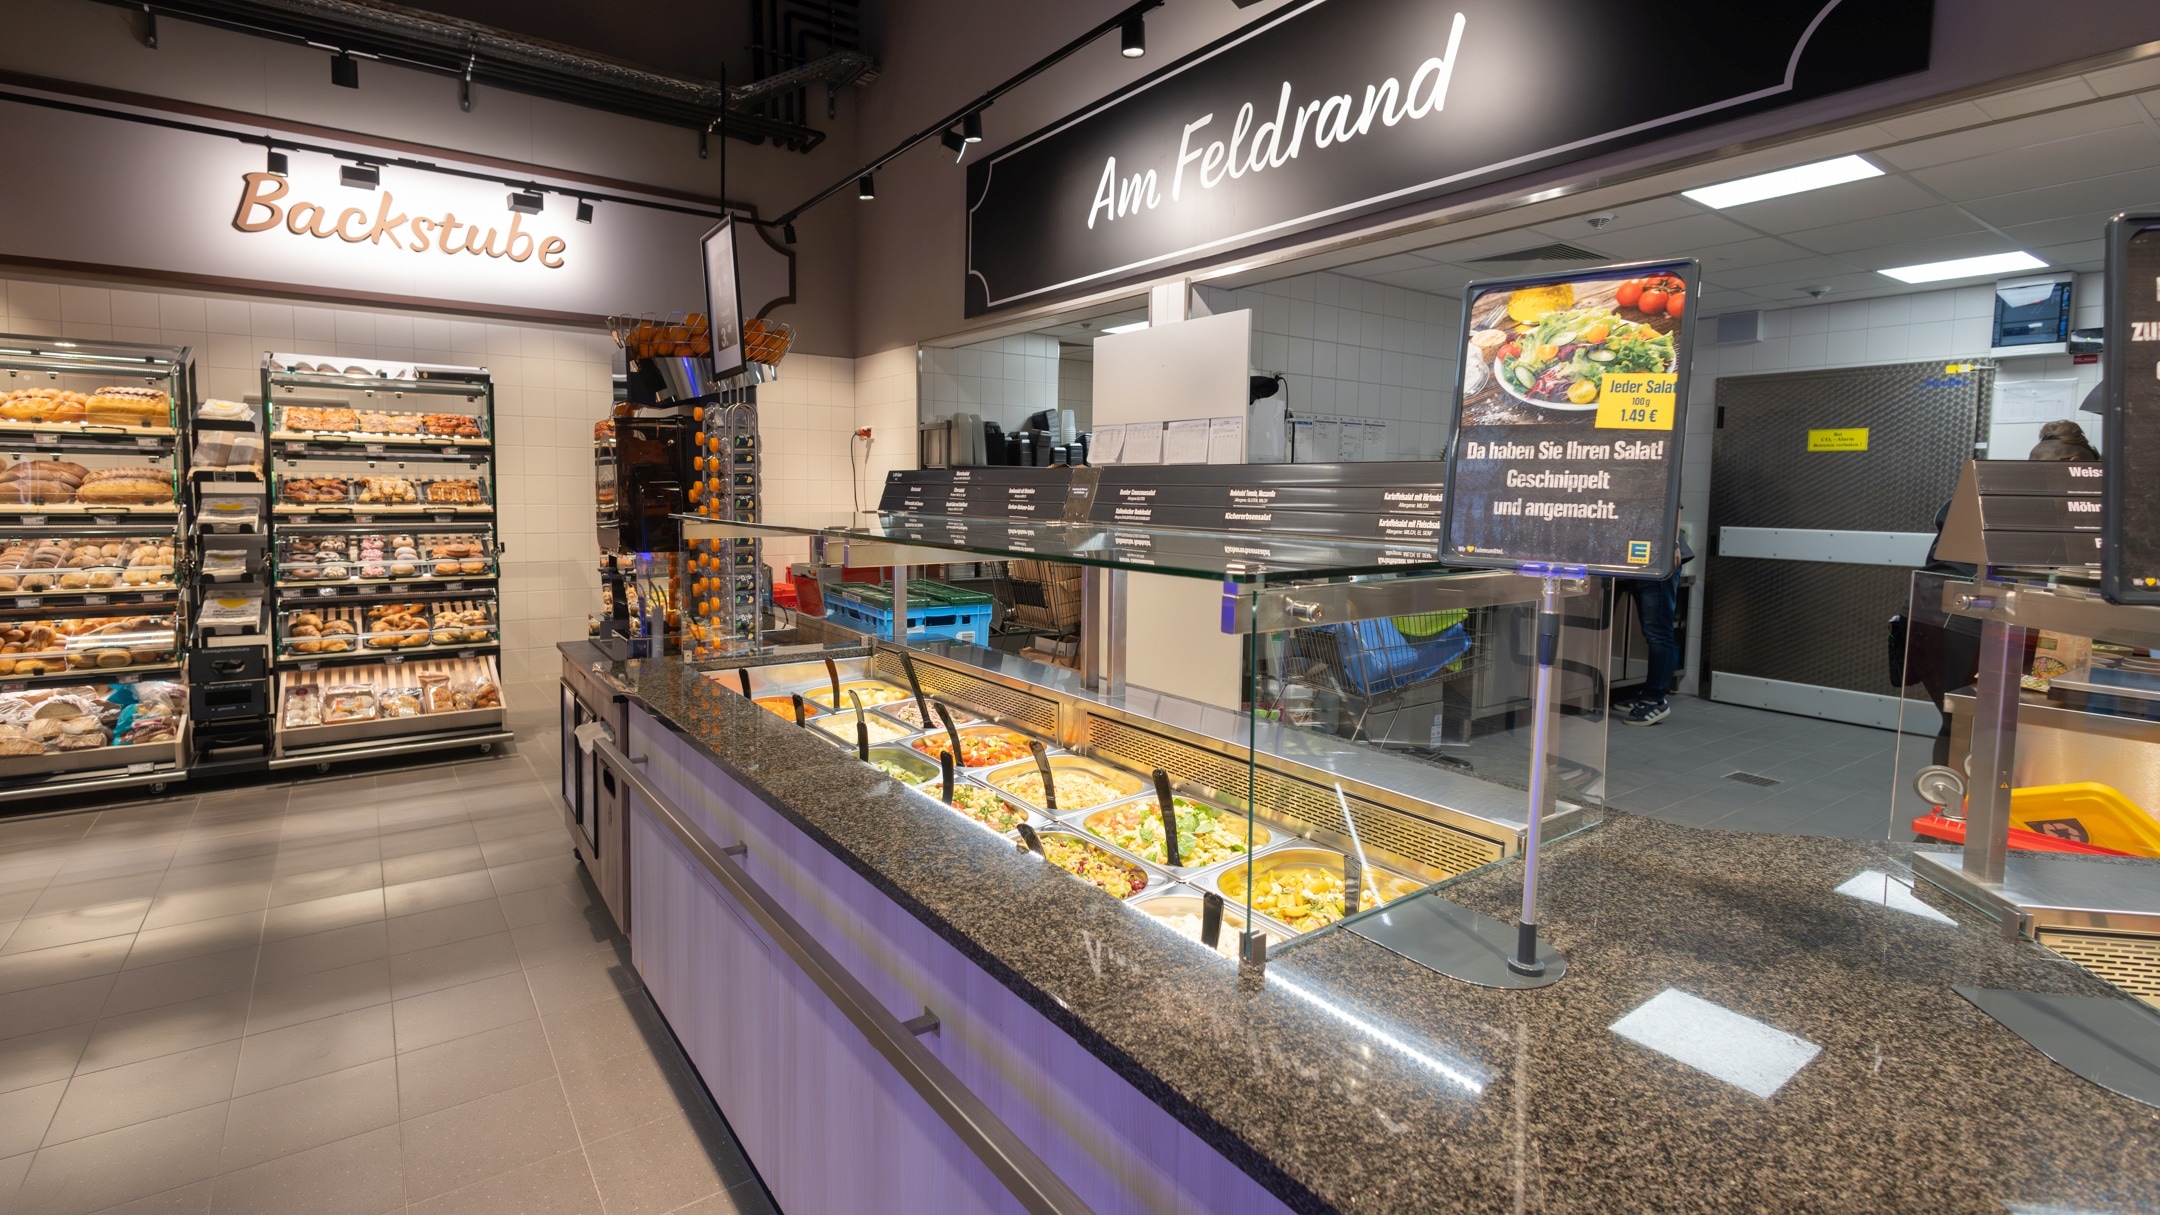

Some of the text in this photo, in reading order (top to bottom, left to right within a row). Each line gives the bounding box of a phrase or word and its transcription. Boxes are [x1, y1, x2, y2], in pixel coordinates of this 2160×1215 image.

[1088, 12, 1466, 229] Am Feldrand
[231, 172, 566, 268] Backstube
[1610, 380, 1643, 393] Jeder
[1646, 399, 1650, 407] g
[1621, 409, 1658, 422] 1.49 €
[1467, 441, 1663, 460] Da haben Sie Ihren Salat!
[1507, 470, 1610, 493] Geschnippelt
[1384, 492, 1414, 501] Kartoffelsalat
[1494, 498, 1619, 521] und angemacht.
[1224, 512, 1272, 521] Kichererbsensalat
[1379, 519, 1408, 527] Kartoffelsalat
[1408, 520, 1416, 528] mit
[2133, 578, 2144, 586] Wir
